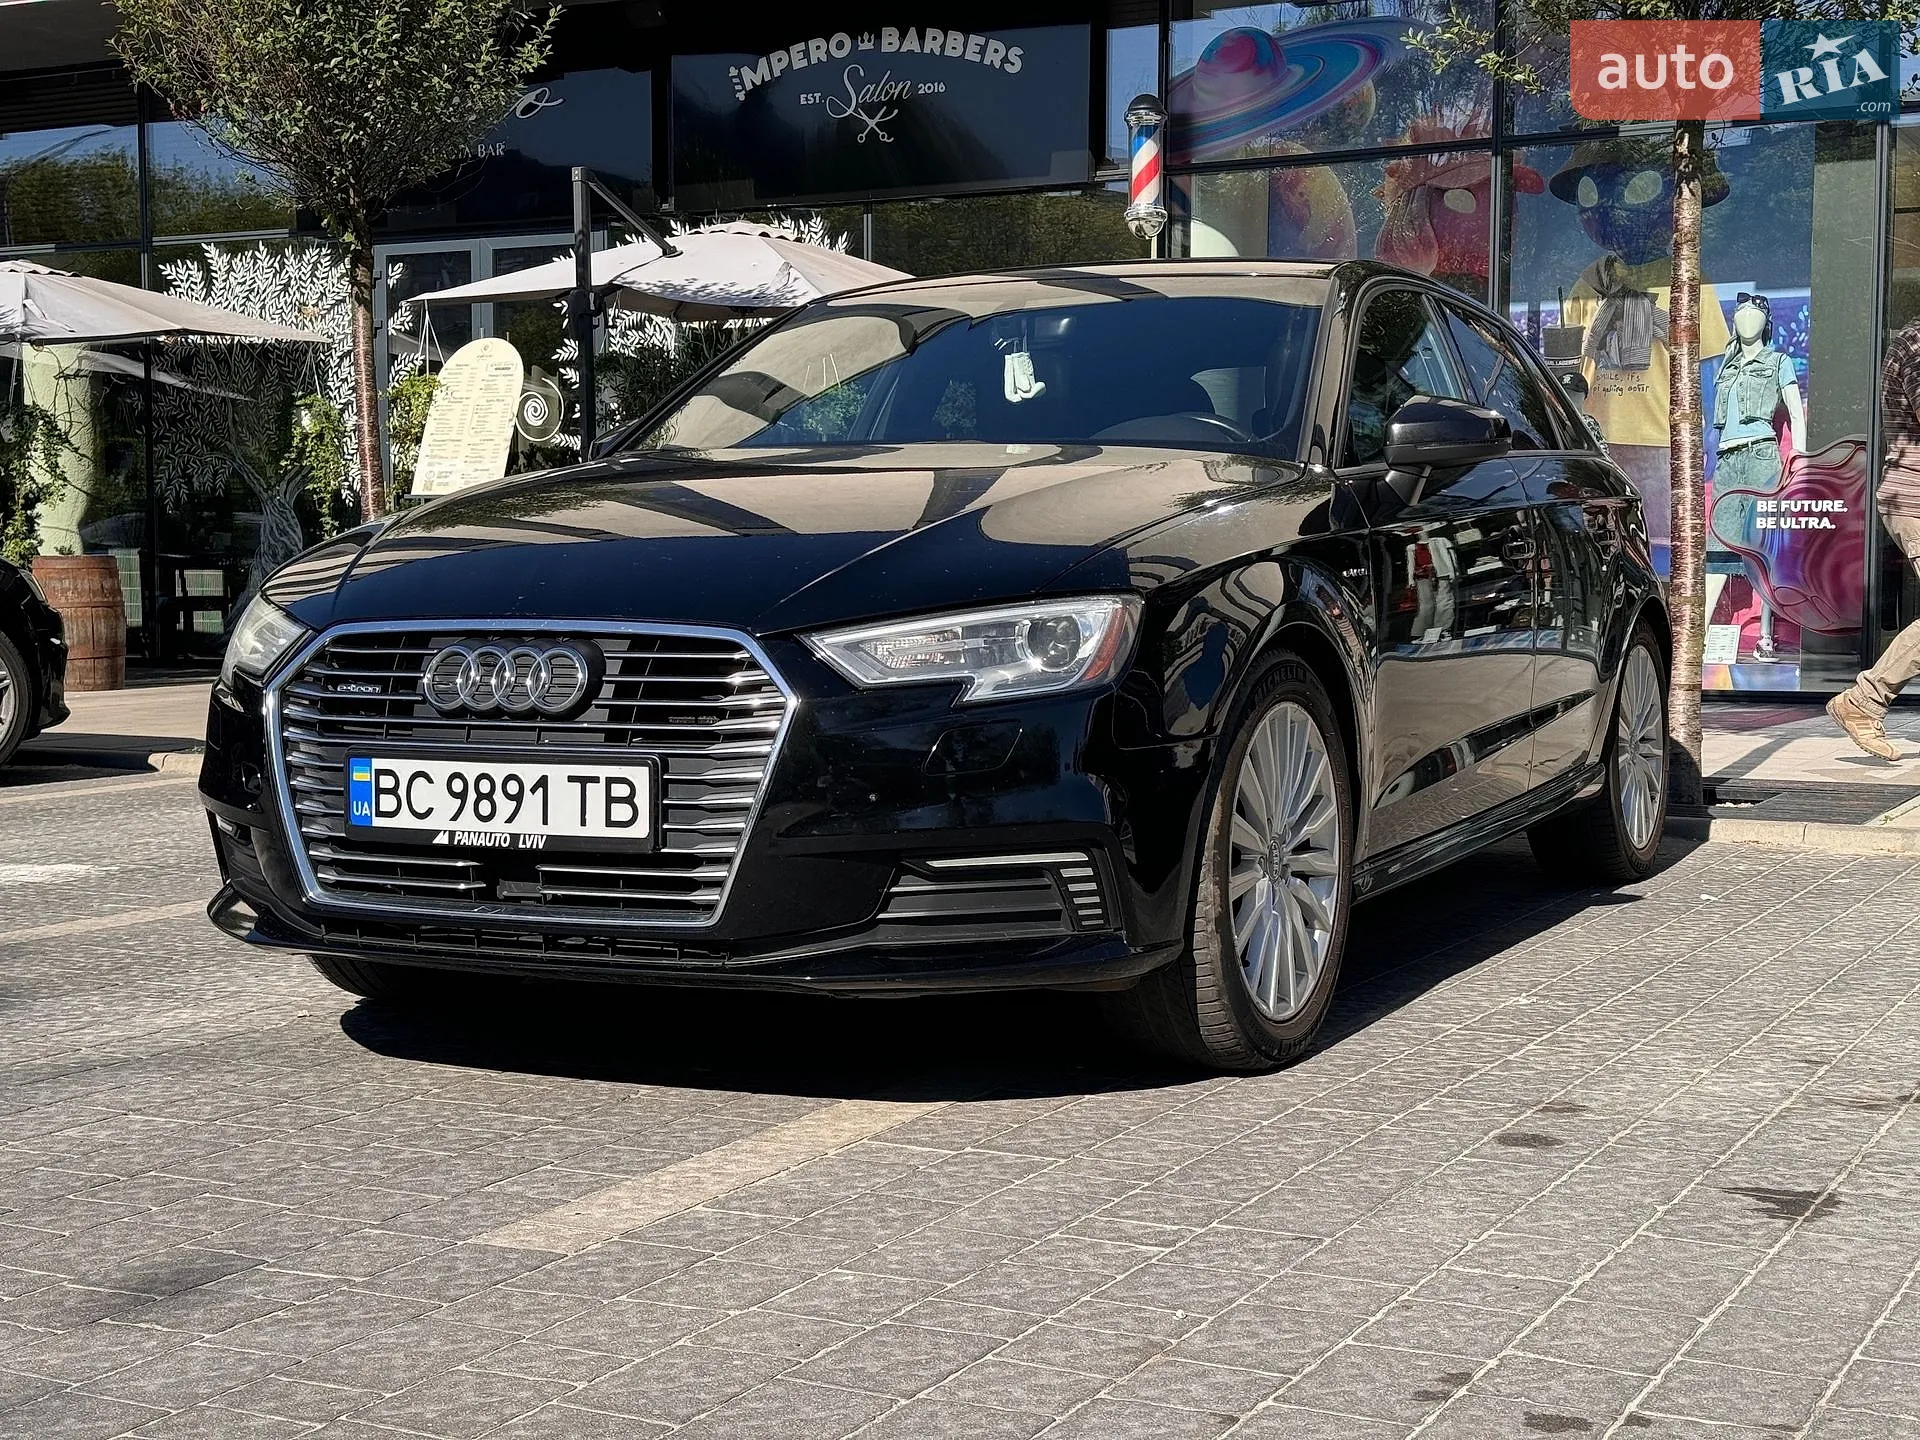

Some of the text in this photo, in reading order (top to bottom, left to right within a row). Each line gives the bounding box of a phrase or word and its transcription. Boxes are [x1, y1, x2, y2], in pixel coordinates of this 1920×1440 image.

[881, 26, 1025, 74] BARBERS
[800, 64, 946, 118] EST. Salon 2016
[477, 142, 506, 158] BAR
[1756, 500, 1848, 513] BE FUTURE.
[1755, 517, 1837, 530] BE ULTRA.
[337, 683, 382, 693] e-tron
[374, 768, 640, 828] BC 9891 TB
[353, 800, 371, 817] UA
[454, 831, 548, 850] PANAUTO LVIV
